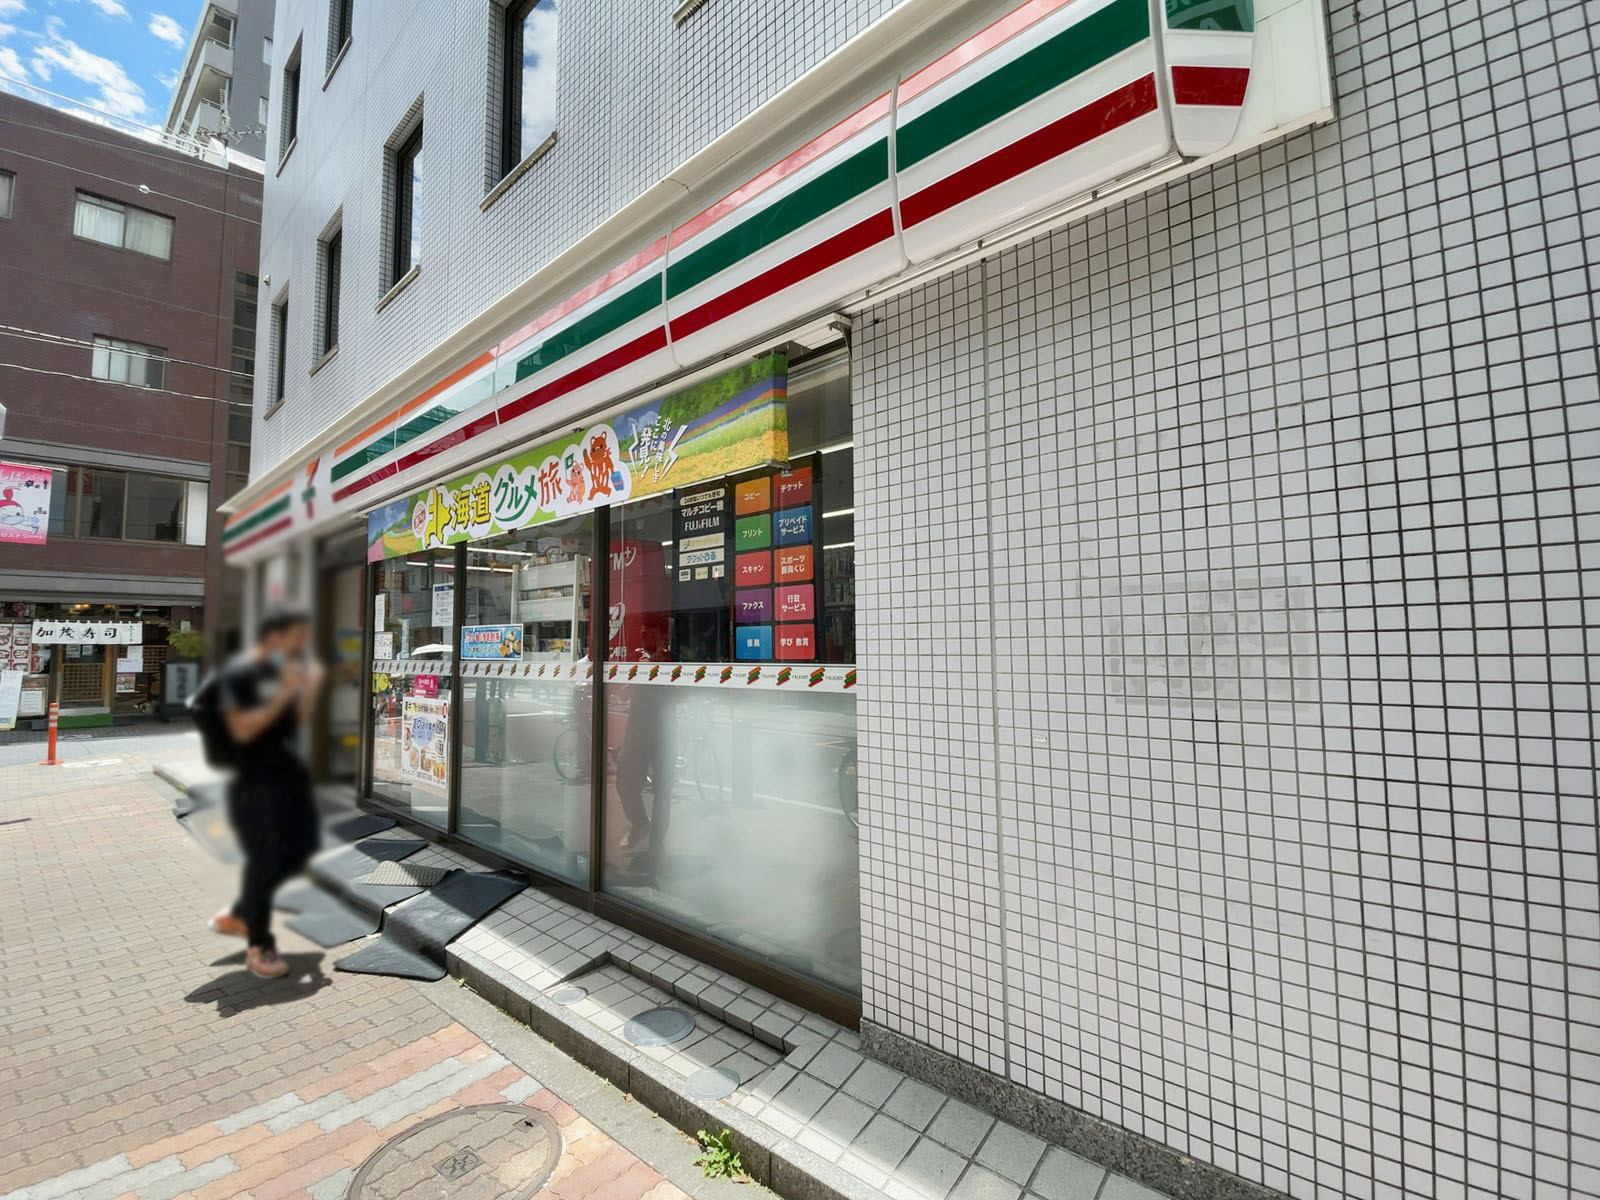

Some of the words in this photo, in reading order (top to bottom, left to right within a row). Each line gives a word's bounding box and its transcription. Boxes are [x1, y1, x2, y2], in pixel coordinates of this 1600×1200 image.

[649, 413, 662, 451] ここに
[780, 481, 803, 493] チケット
[744, 491, 761, 501] コピー
[778, 515, 807, 527] プリペイド
[742, 528, 763, 538] プリント
[781, 525, 806, 536] サービス
[781, 555, 806, 565] スポーツ
[742, 566, 764, 575] スキャン
[742, 601, 764, 611] ファクス
[781, 603, 806, 613] サービス
